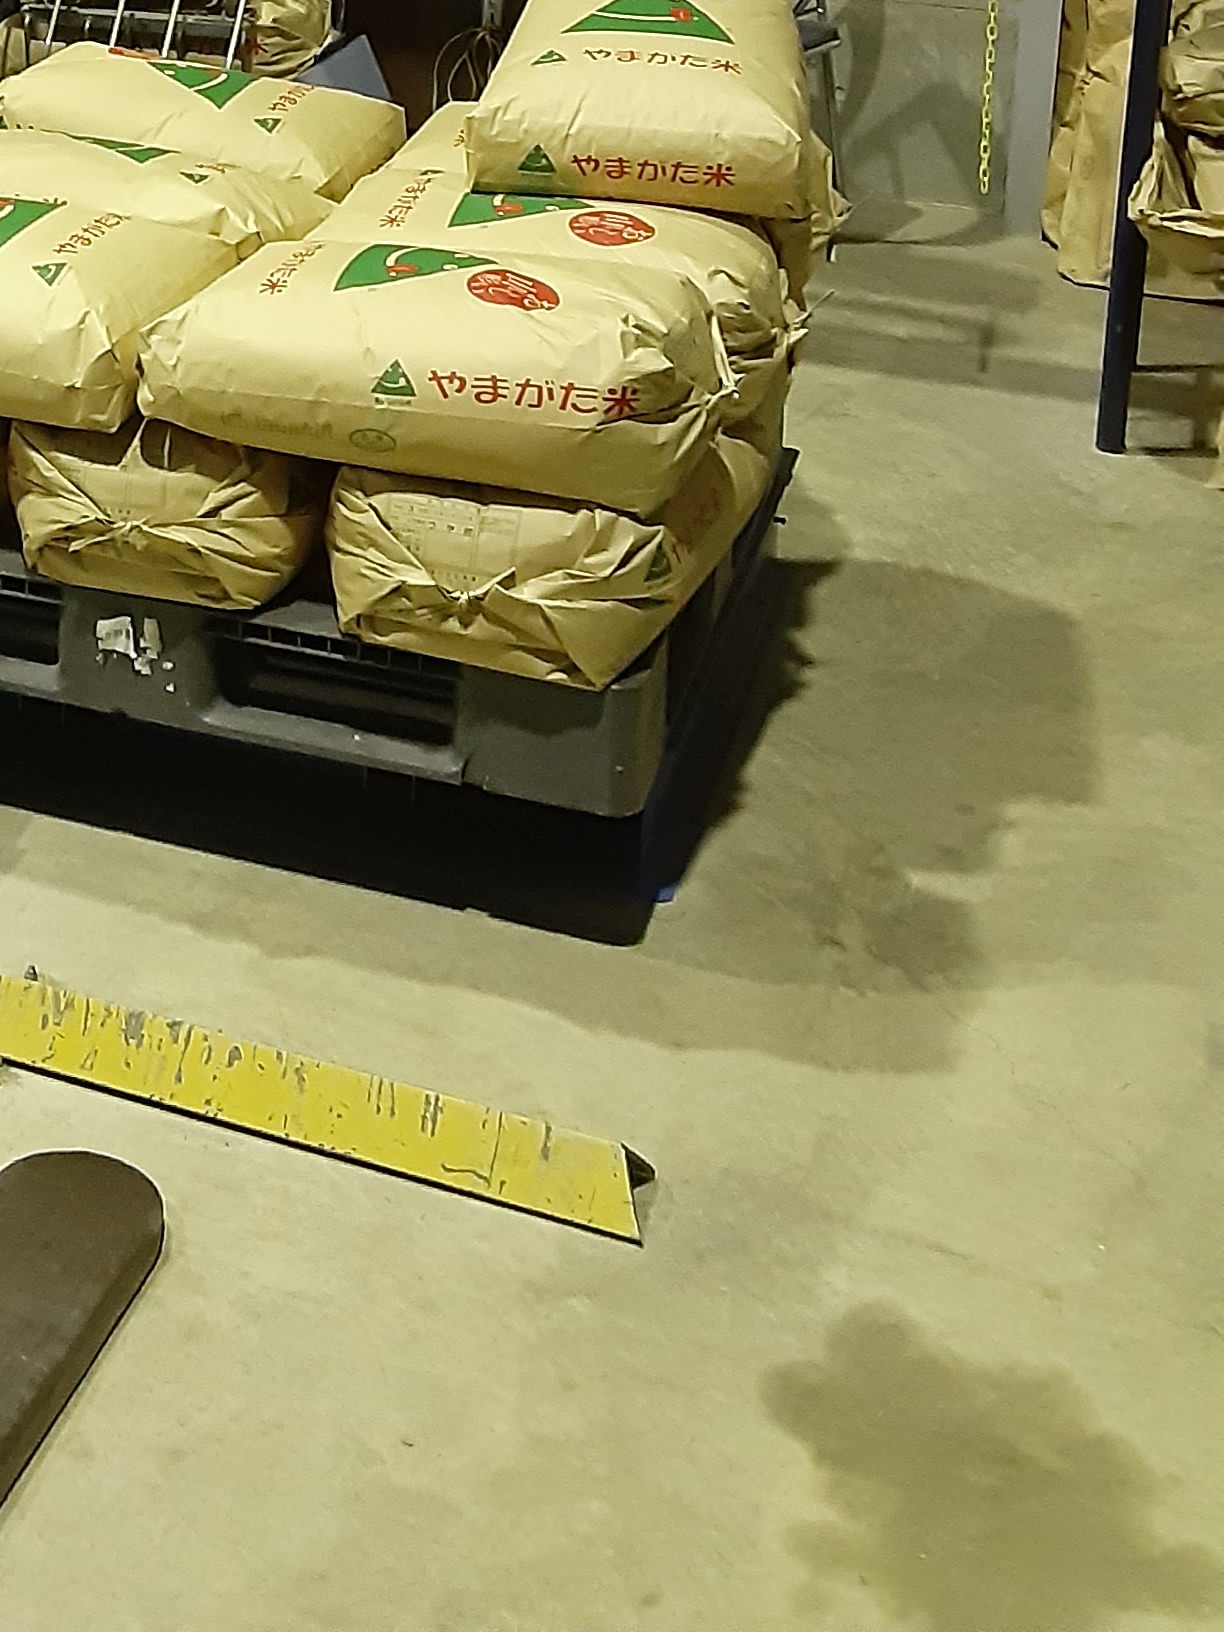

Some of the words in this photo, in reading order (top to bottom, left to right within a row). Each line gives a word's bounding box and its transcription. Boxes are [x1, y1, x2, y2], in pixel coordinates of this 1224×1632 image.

[571, 154, 737, 187] やまがた米
[52, 212, 132, 254] やまがた
[428, 369, 640, 416] やまがた米
